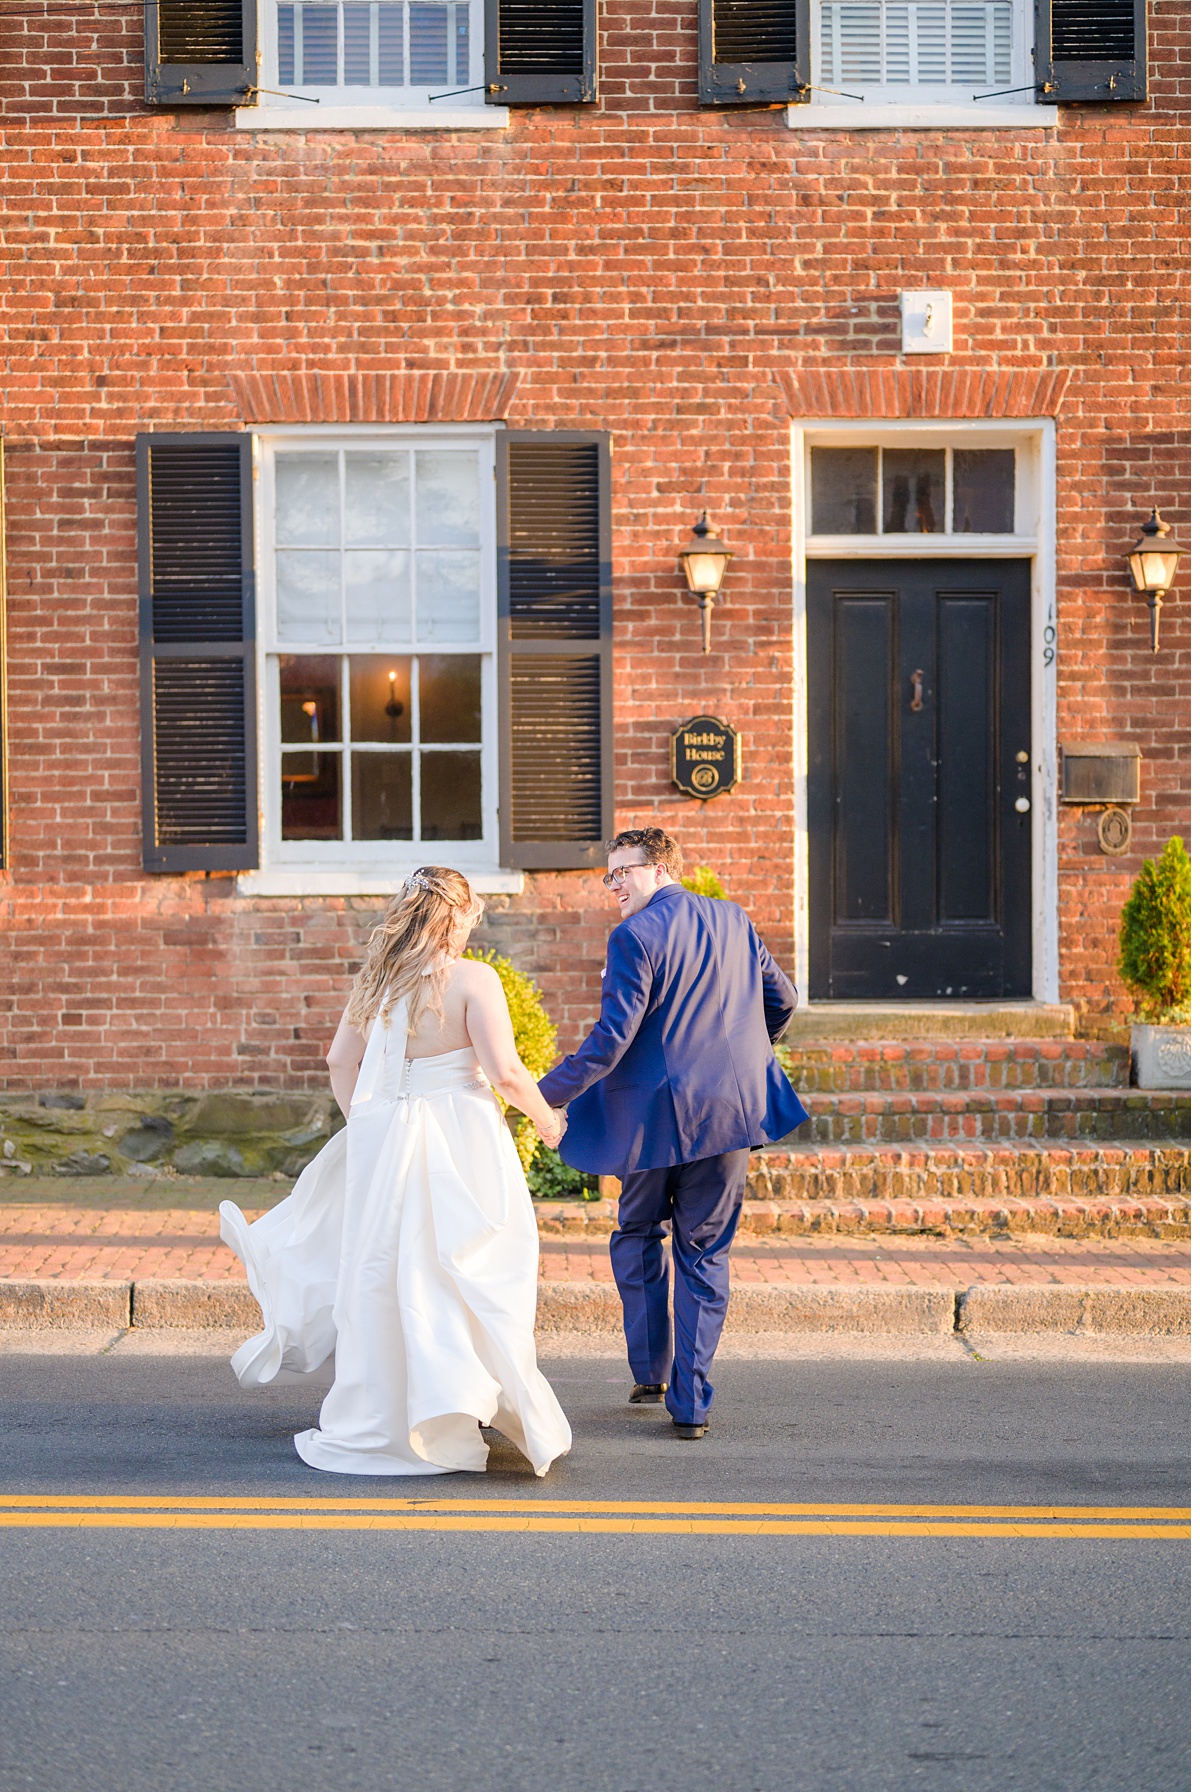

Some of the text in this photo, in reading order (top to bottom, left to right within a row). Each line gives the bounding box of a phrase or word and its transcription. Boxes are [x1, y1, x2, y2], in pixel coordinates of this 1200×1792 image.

[1043, 603, 1055, 668] 109
[684, 732, 726, 749] Birkby
[686, 748, 725, 761] House
